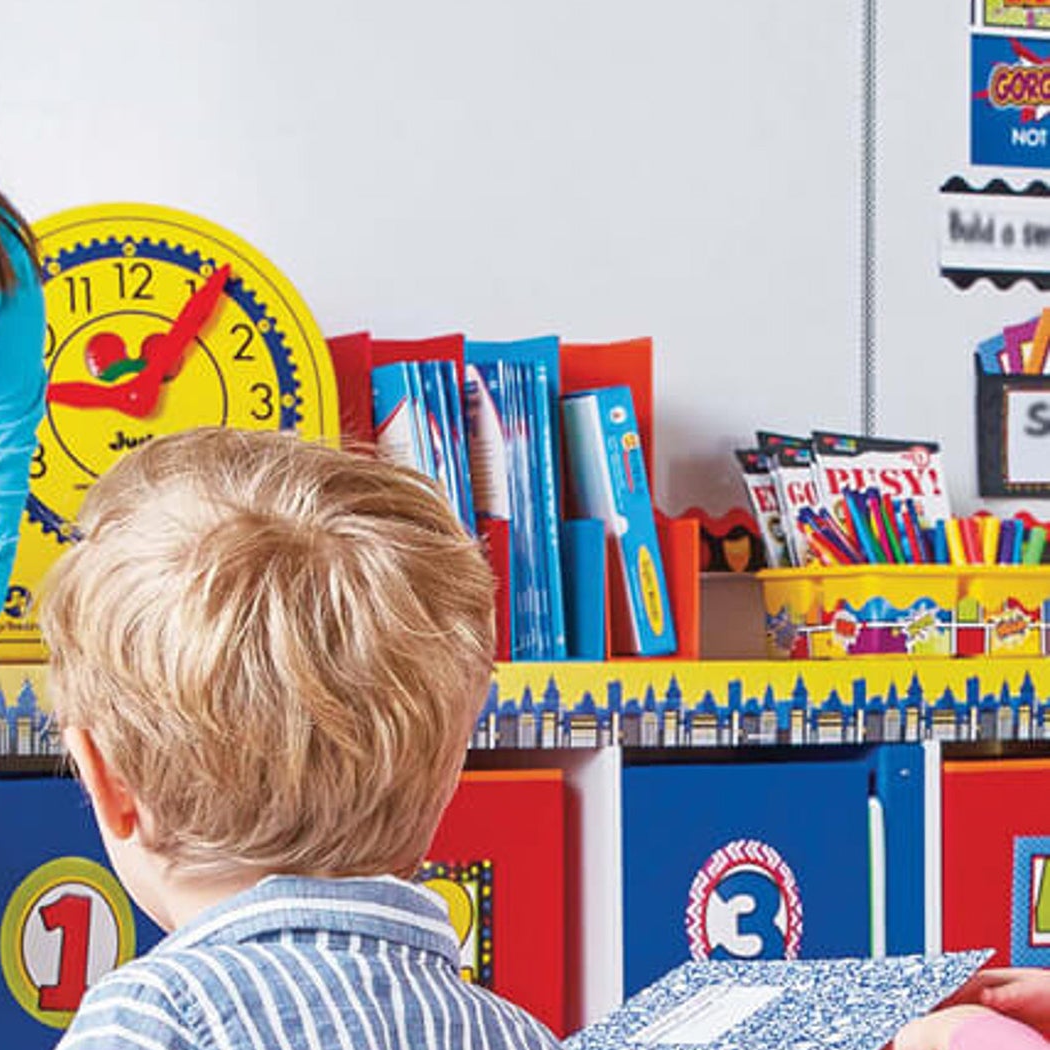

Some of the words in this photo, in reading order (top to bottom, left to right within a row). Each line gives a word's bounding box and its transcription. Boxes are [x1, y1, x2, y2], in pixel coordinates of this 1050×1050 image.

[64, 276, 92, 314] 11
[113, 262, 155, 301] 12
[230, 323, 256, 361] 2
[250, 382, 274, 421] 3
[707, 869, 786, 961] 3
[38, 893, 93, 1012] 1
